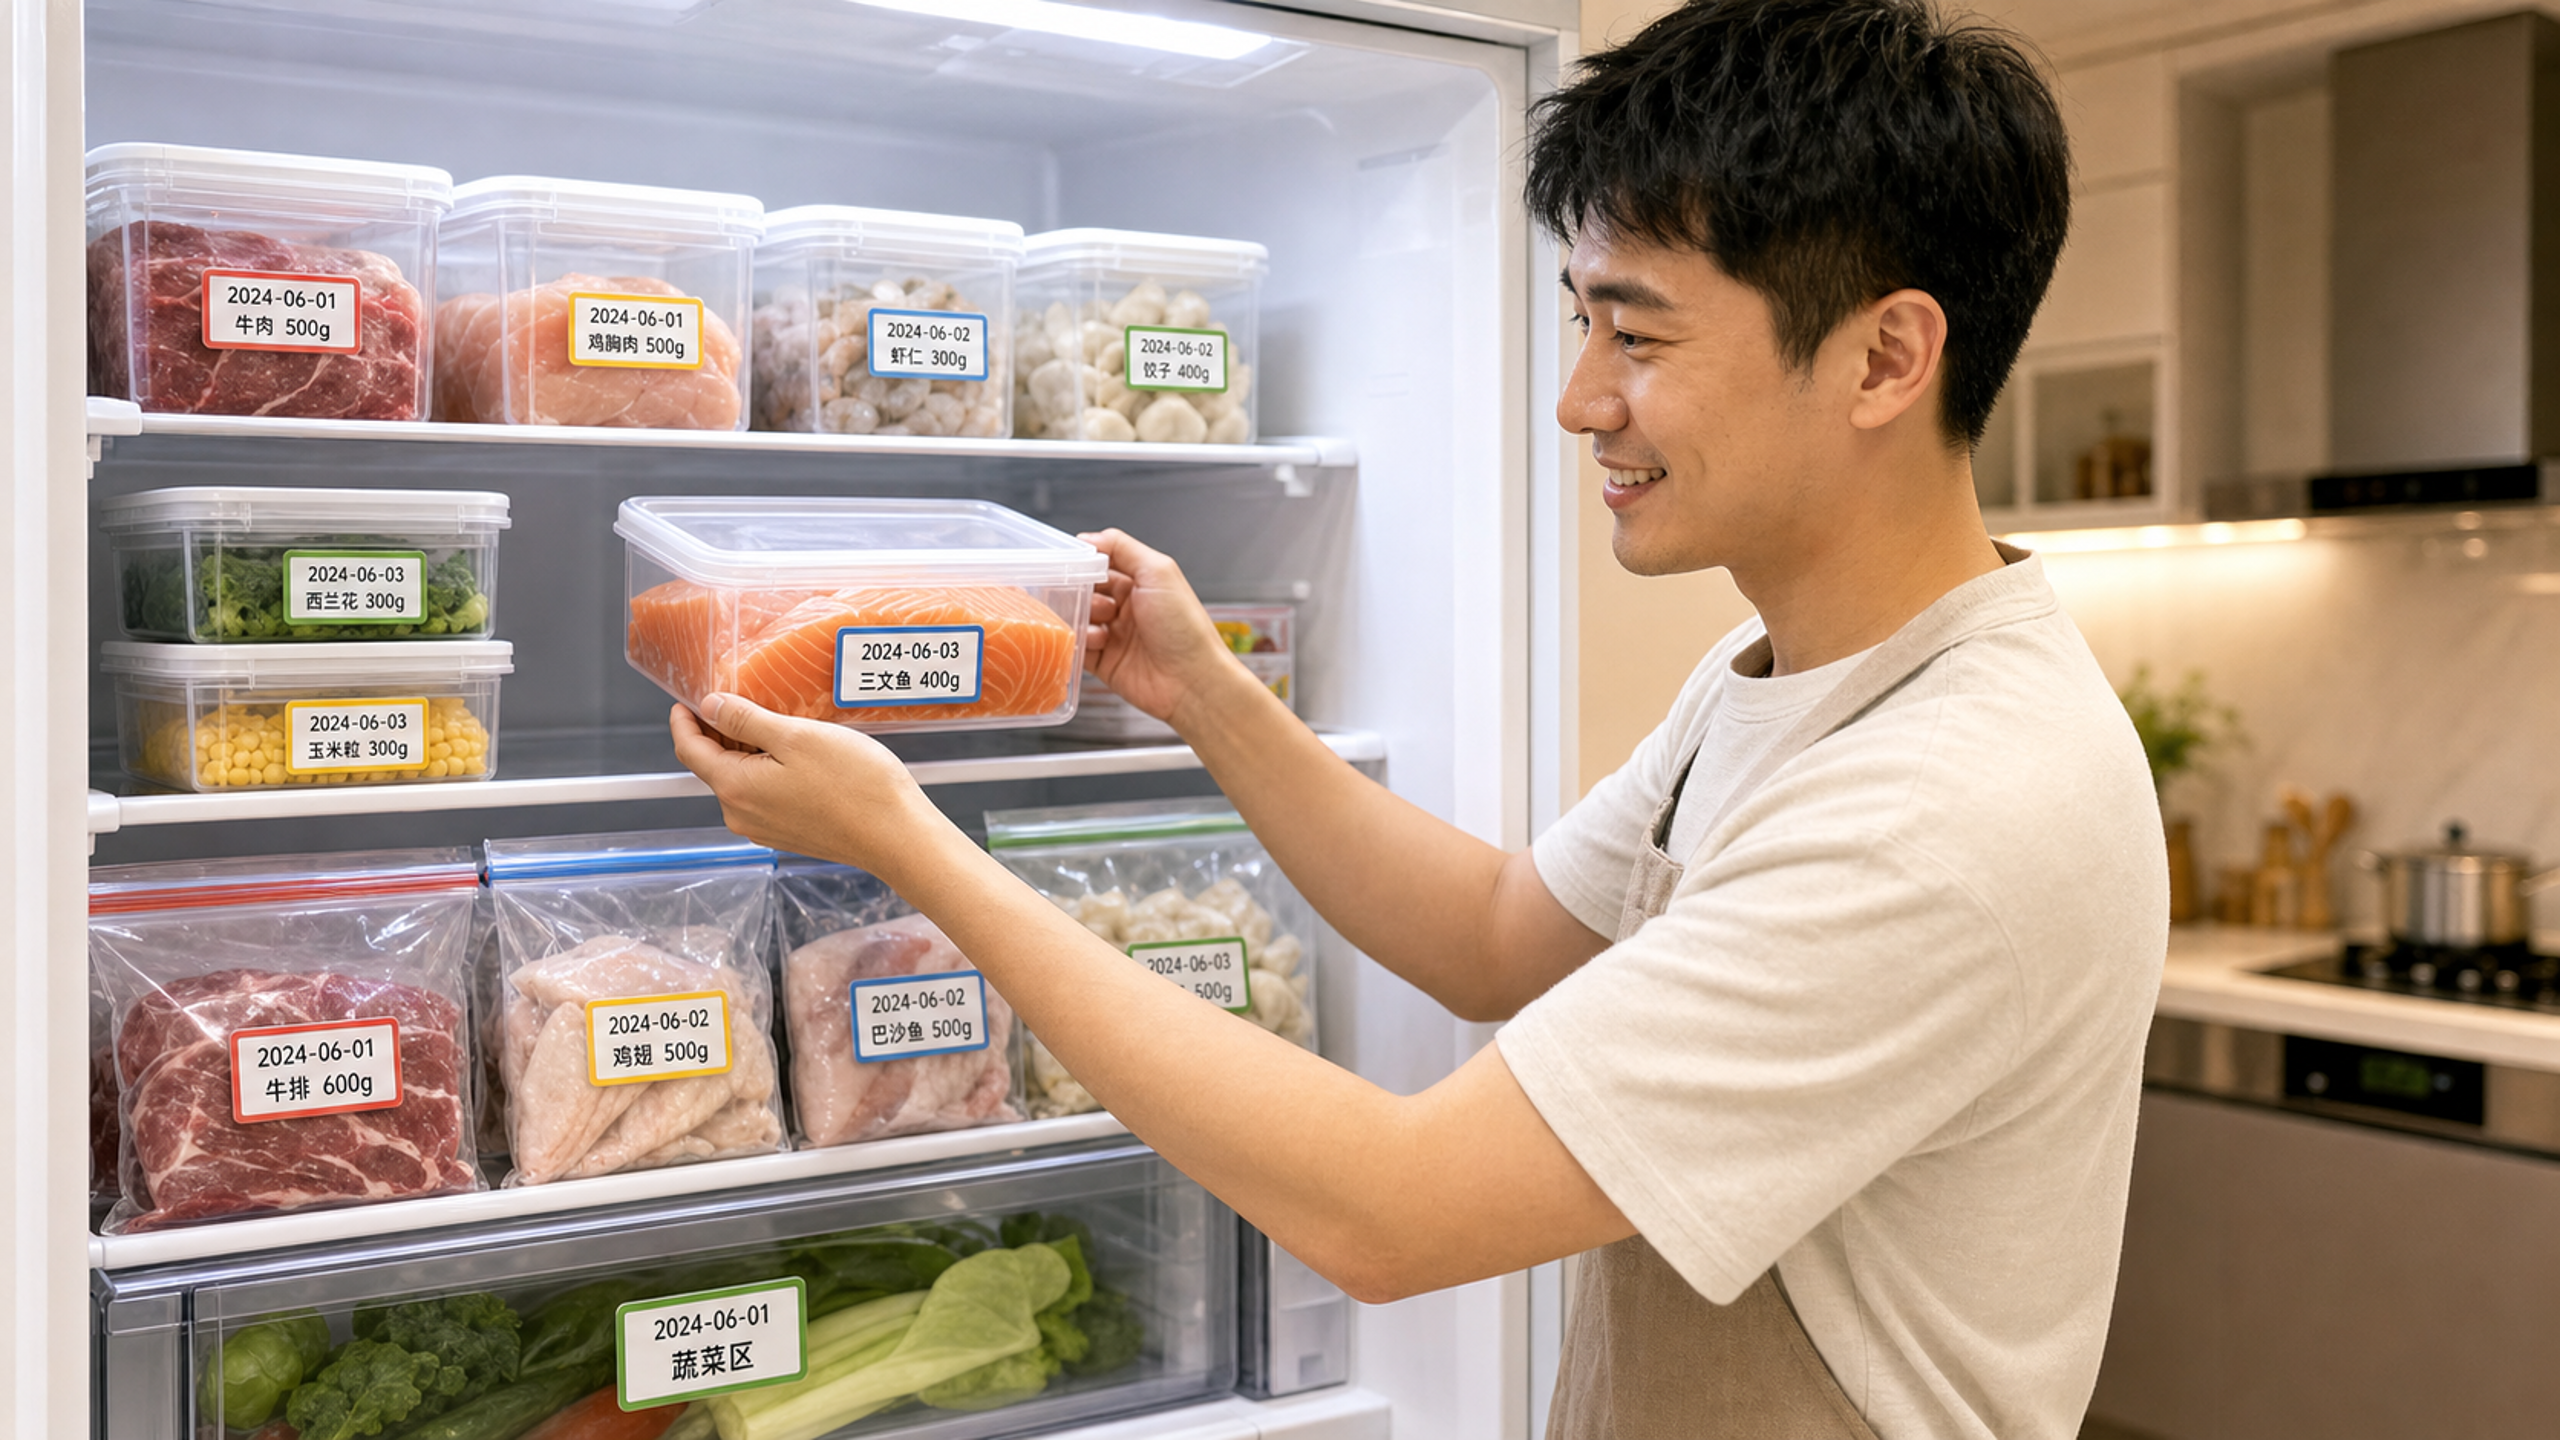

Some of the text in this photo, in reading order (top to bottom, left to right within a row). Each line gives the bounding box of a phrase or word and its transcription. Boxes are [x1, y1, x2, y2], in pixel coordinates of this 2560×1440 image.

[227, 285, 335, 310] 2024-06-01
[235, 314, 330, 342] 牛肉 500g
[590, 307, 682, 328] 2024-06-01
[887, 322, 970, 342] 2024-06-02
[588, 333, 684, 360] 鸡胸肉 500g
[1141, 338, 1212, 357] 2024-06-02
[891, 347, 967, 371] 虾仁 300g
[1143, 362, 1209, 383] 饺子 400g
[308, 565, 405, 583] 2024-06-03
[306, 591, 405, 613] 西兰花 300g
[861, 641, 960, 661] 2024-06-03
[858, 669, 960, 693] 三文鱼 400g
[309, 712, 407, 732] 2024-06-03
[308, 739, 408, 760] 玉米粒 300g
[871, 987, 966, 1014] 2024-06-02
[609, 1008, 710, 1035] 2024-06-02
[871, 1018, 972, 1046] 巴沙鱼 500g
[257, 1038, 373, 1068] 2024-06-01
[613, 1040, 709, 1068] 鸡翅 500g
[265, 1072, 373, 1103] 牛排 600g
[654, 1303, 769, 1341] 2024-06-01
[671, 1340, 755, 1381] 蔬菜区
